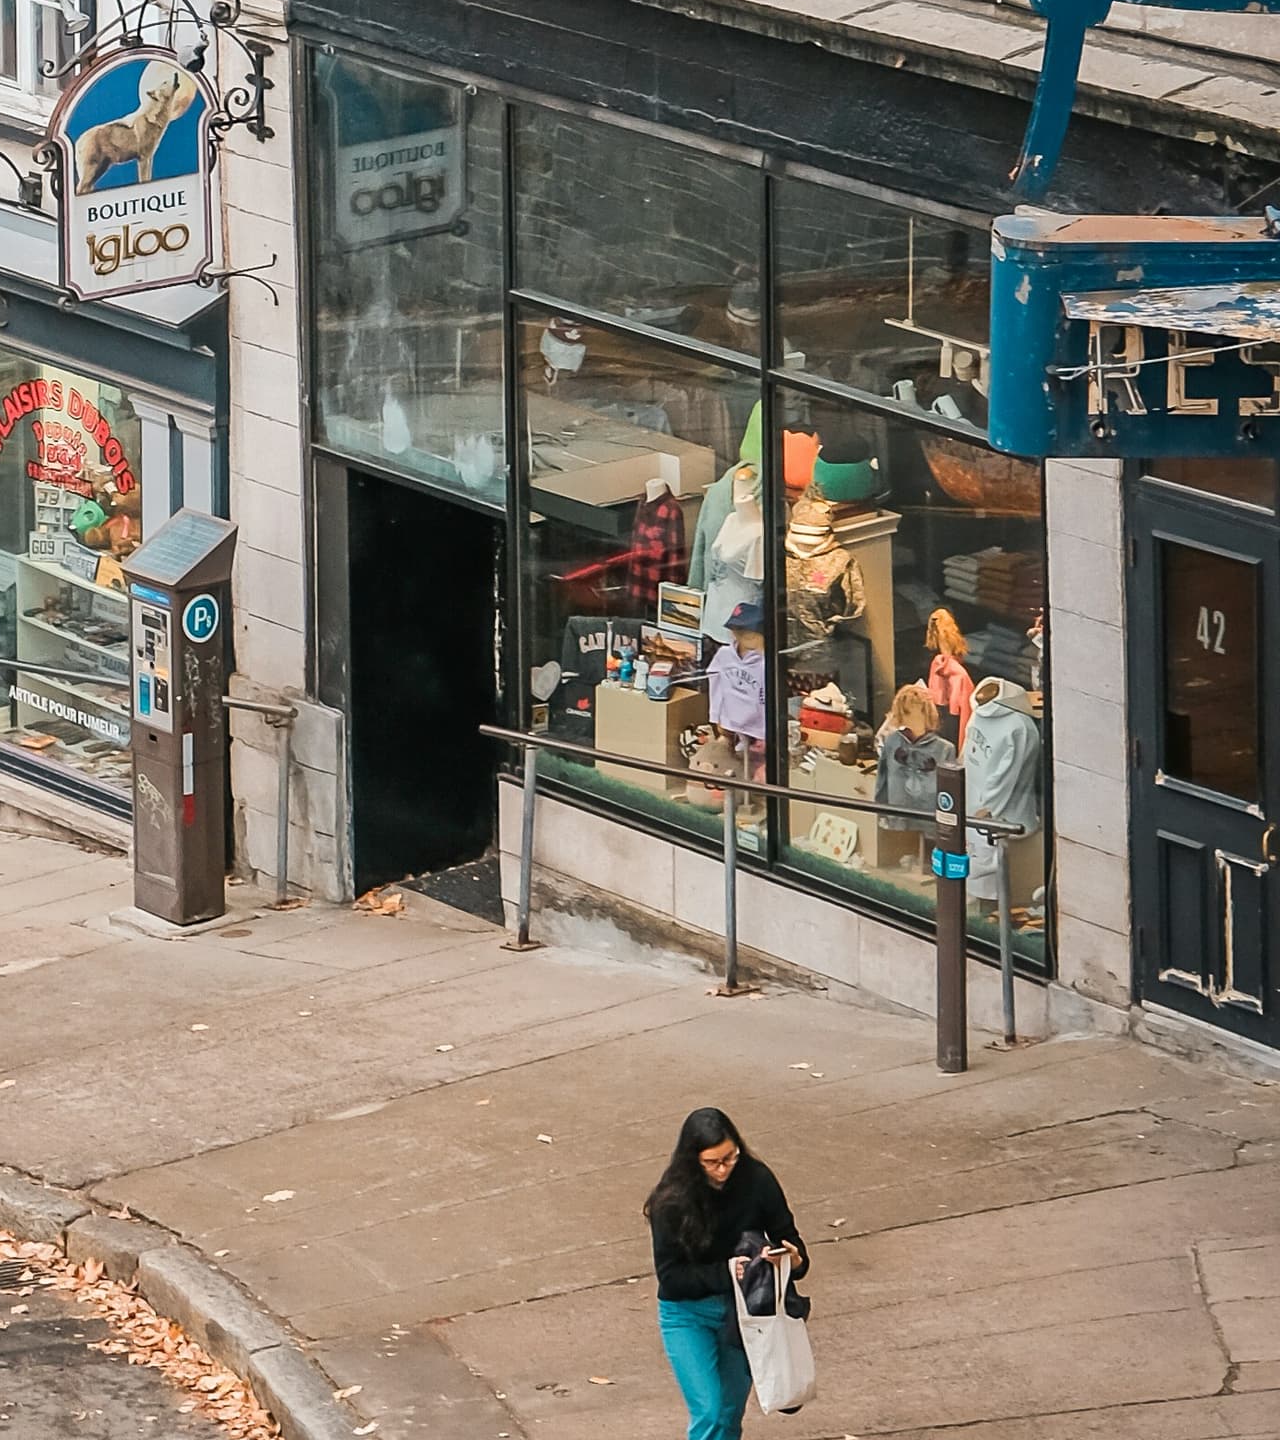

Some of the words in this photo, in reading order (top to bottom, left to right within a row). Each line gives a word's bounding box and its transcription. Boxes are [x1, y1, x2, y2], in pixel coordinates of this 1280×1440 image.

[87, 190, 188, 223] BOUTIQUE
[67, 387, 136, 496] DUBOIS
[1196, 605, 1226, 655] 42
[8, 684, 49, 713] ARTICLE
[48, 699, 78, 724] POUR
[77, 710, 120, 739] FUMEUR
